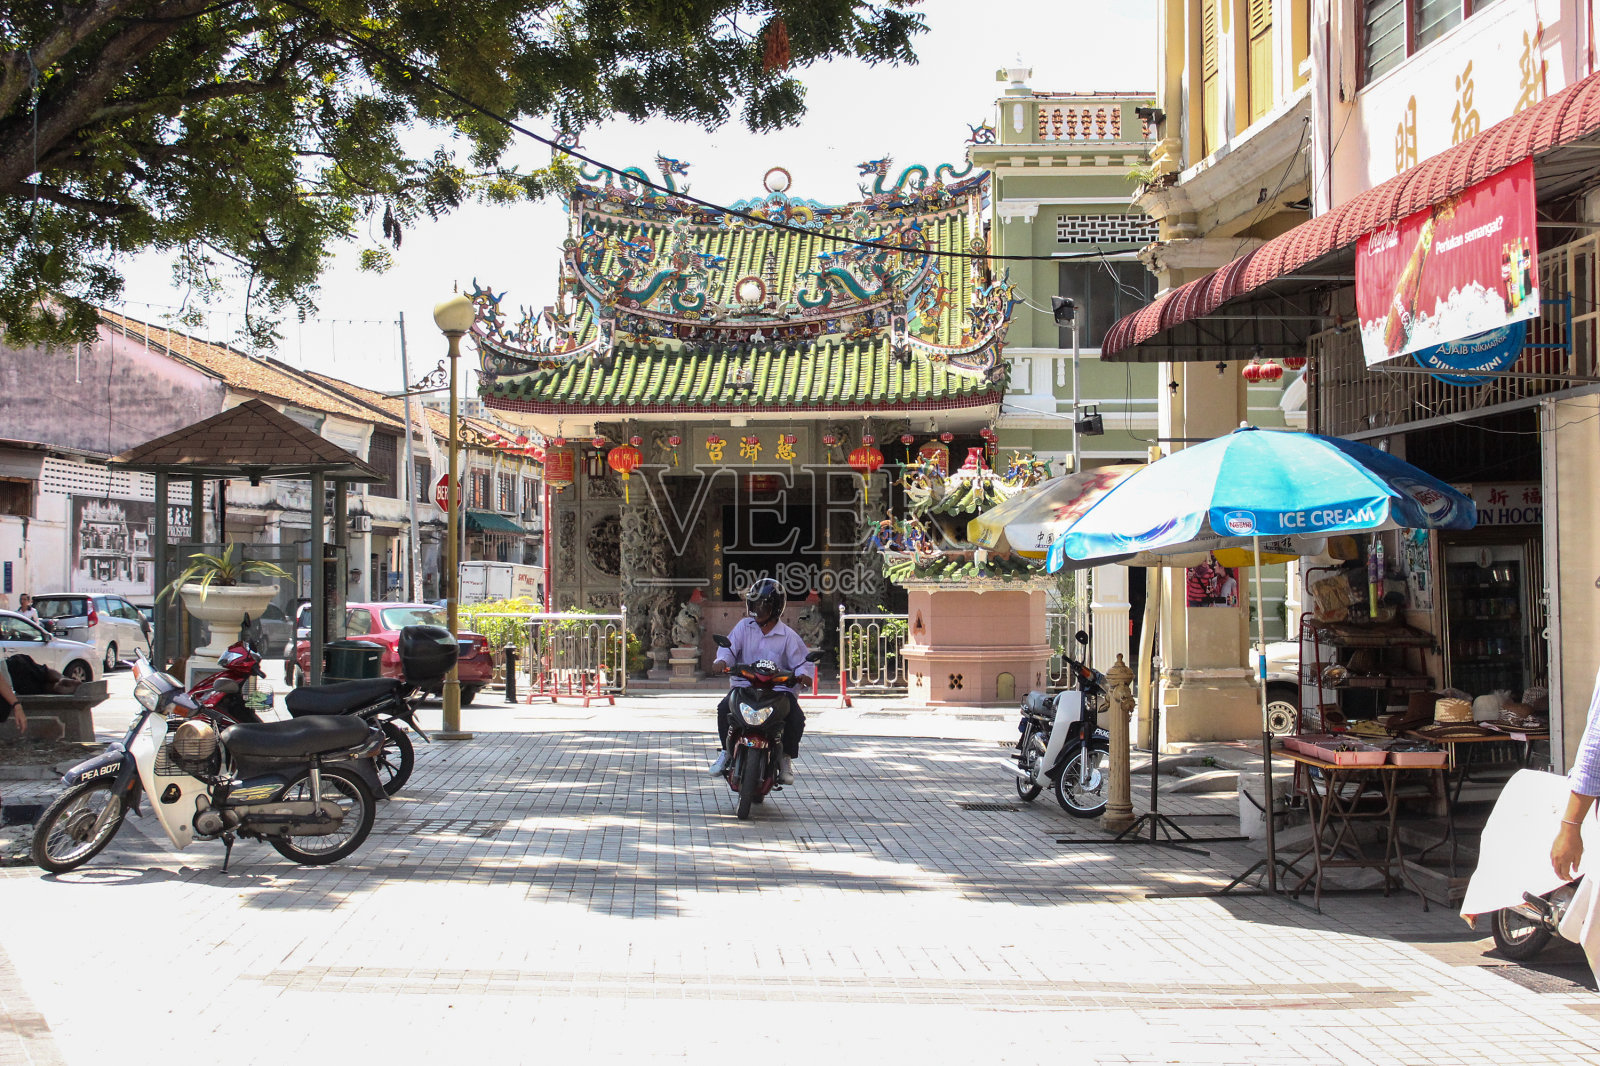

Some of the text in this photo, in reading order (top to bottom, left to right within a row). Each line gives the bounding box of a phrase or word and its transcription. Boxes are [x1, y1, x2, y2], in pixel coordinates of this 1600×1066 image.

[1435, 215, 1504, 255] Perlukan semangat?
[1436, 343, 1469, 355] AJAIB
[1279, 511, 1306, 529] ICE
[1310, 506, 1376, 527] CREAM
[1475, 506, 1543, 525] IN HOCK
[81, 762, 121, 782] PEA 8071
